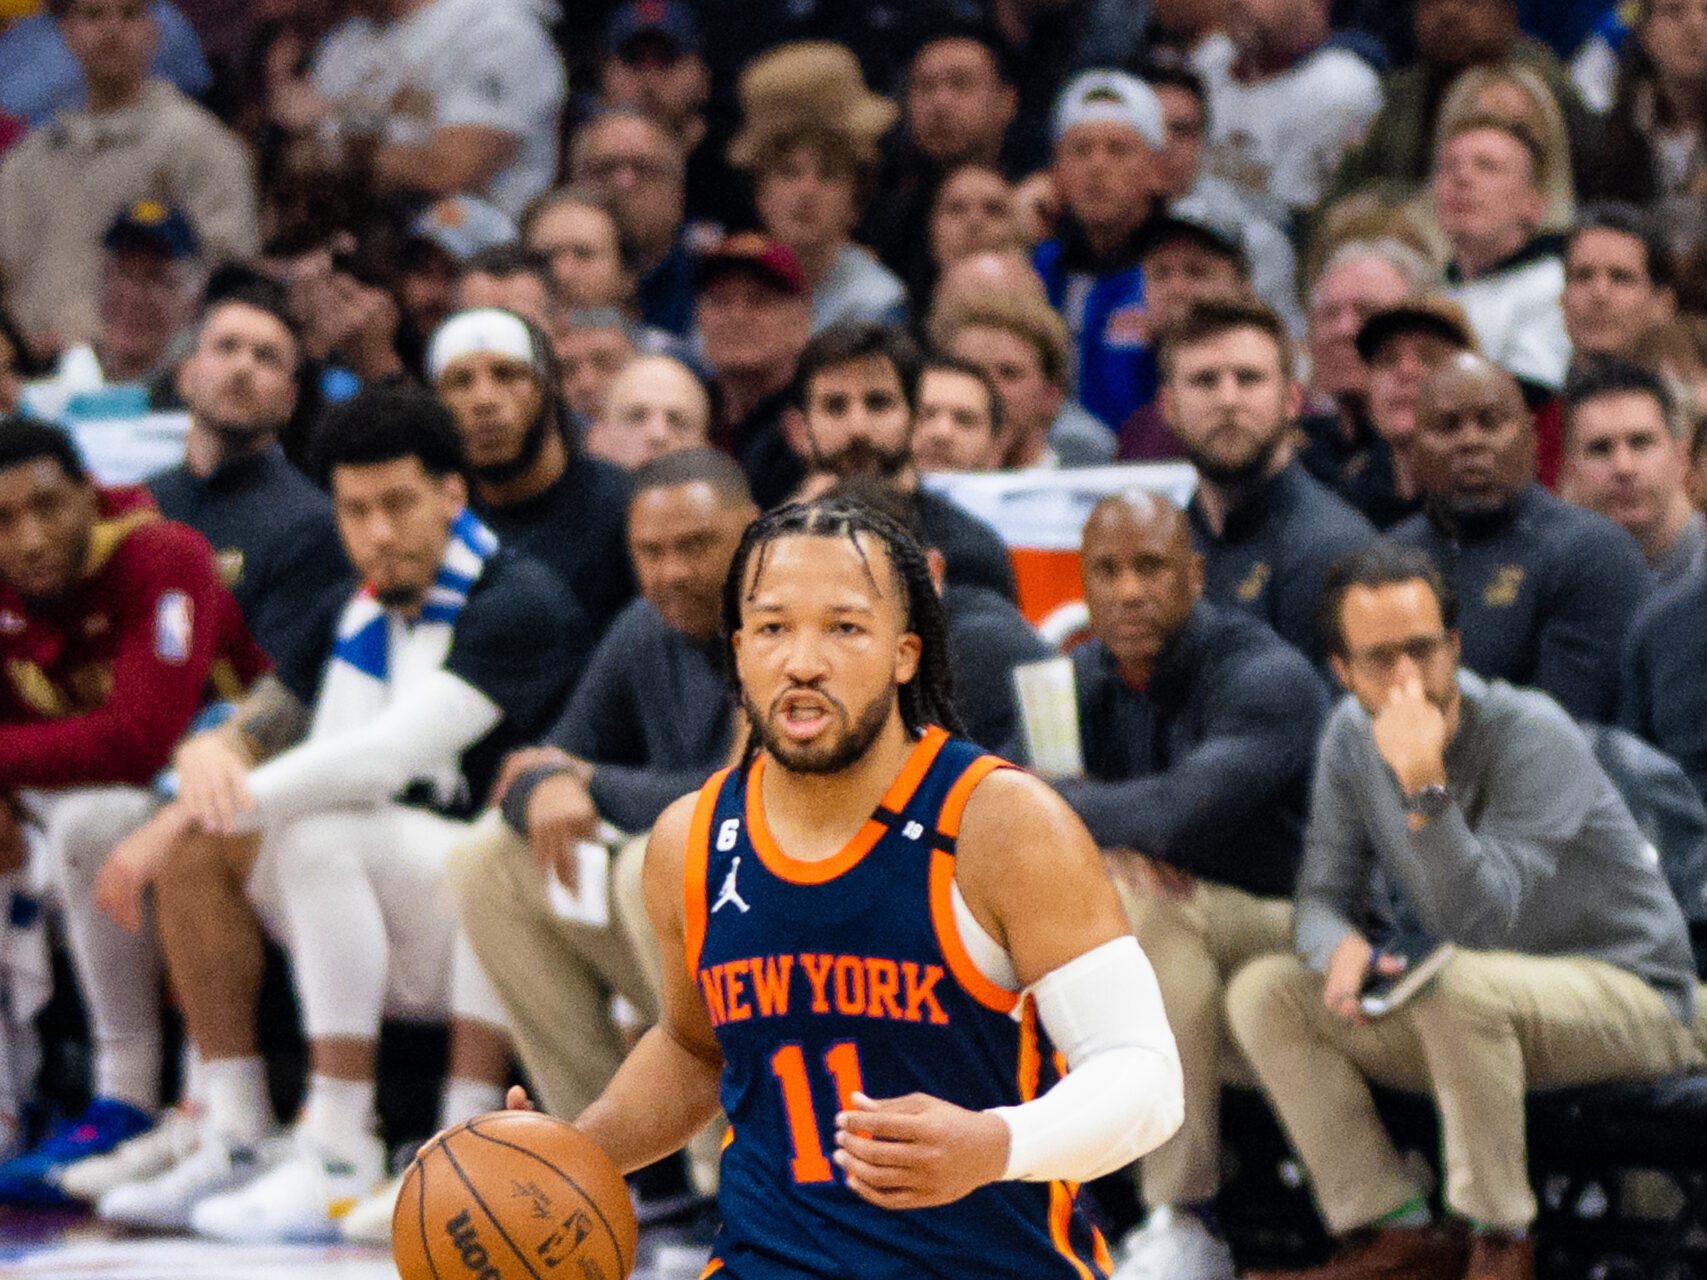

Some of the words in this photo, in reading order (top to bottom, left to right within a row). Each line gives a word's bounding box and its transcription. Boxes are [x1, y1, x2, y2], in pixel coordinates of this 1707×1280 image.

[716, 818, 740, 852] 6
[701, 954, 795, 1027] NEW
[798, 952, 949, 1025] YORK
